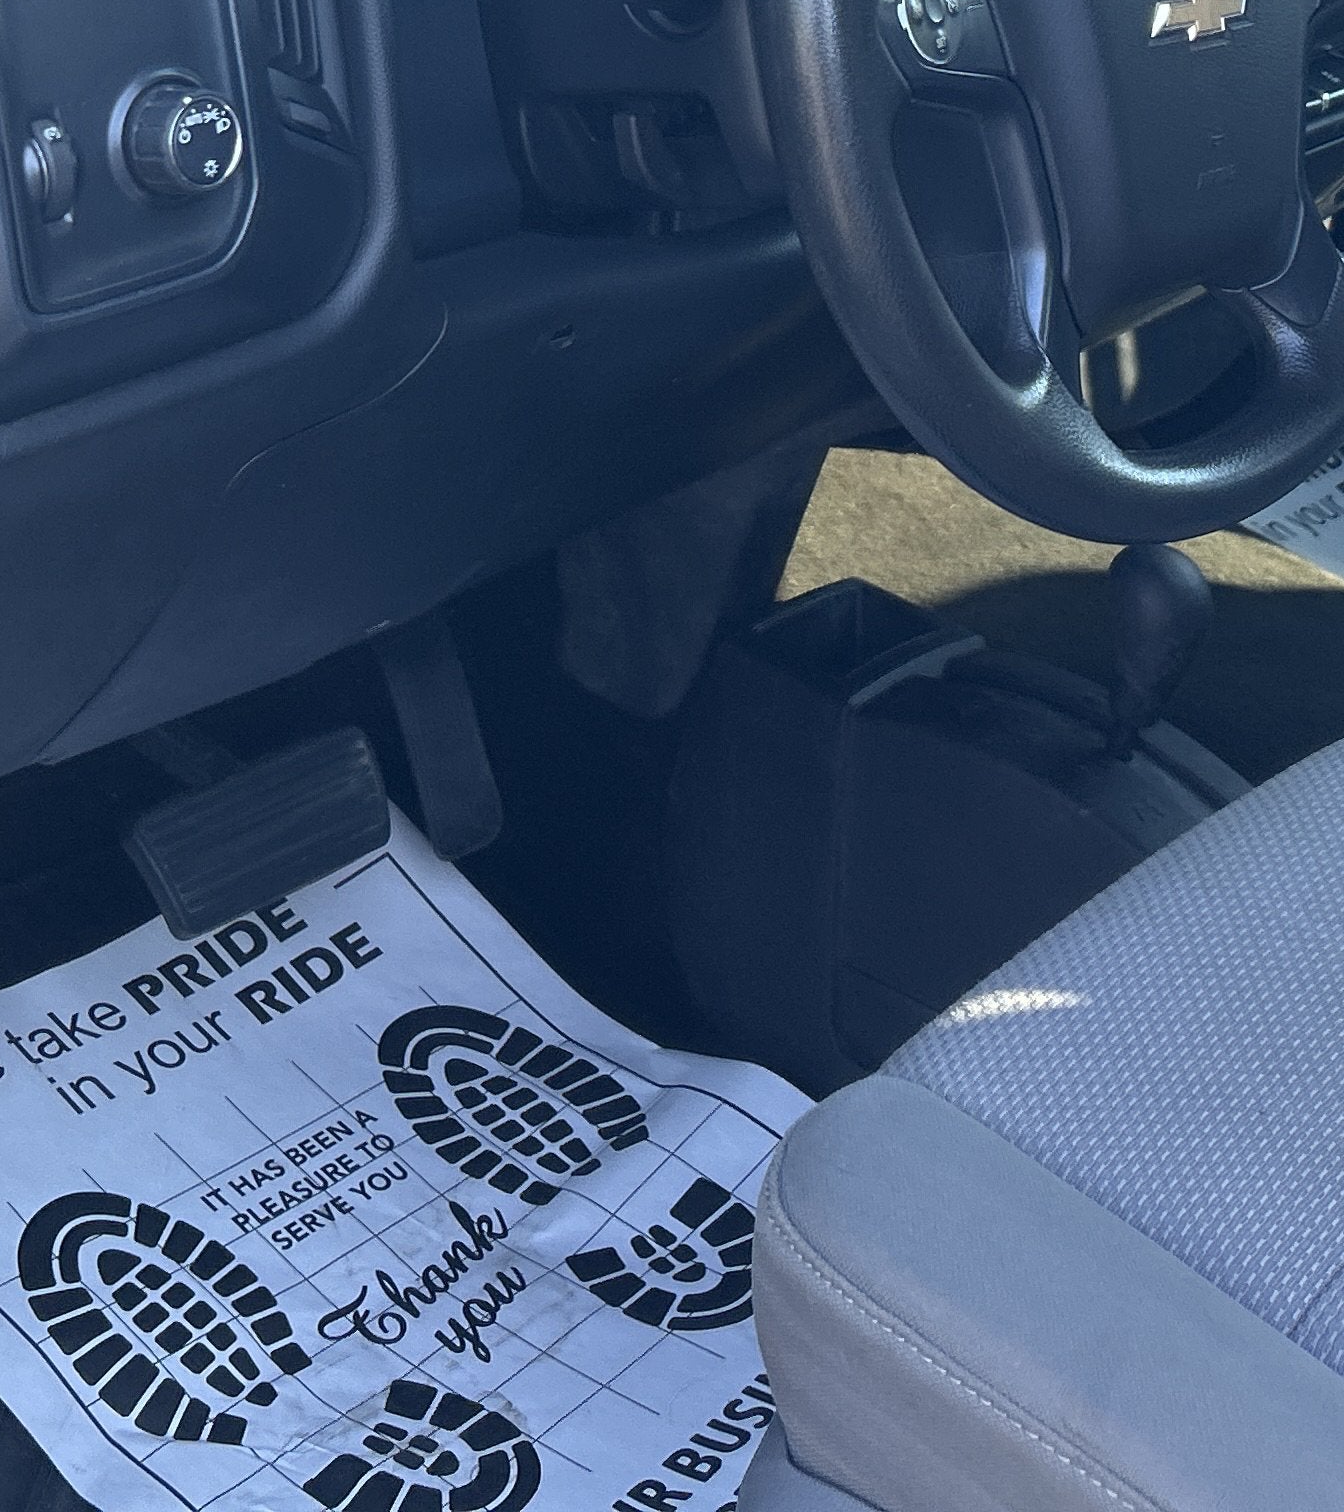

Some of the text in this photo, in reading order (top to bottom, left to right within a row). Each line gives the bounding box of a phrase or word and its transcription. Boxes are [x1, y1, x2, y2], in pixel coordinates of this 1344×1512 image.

[4, 1000, 128, 1065] take
[122, 897, 308, 1015] PRIDE
[47, 921, 384, 1115] in your RIDE
[199, 1109, 379, 1213] IT HAS BEEN A
[230, 1133, 396, 1235] PLEASURE TO
[270, 1161, 409, 1251] SERVE YOU
[317, 1199, 509, 1345] Thank
[433, 1266, 527, 1365] you
